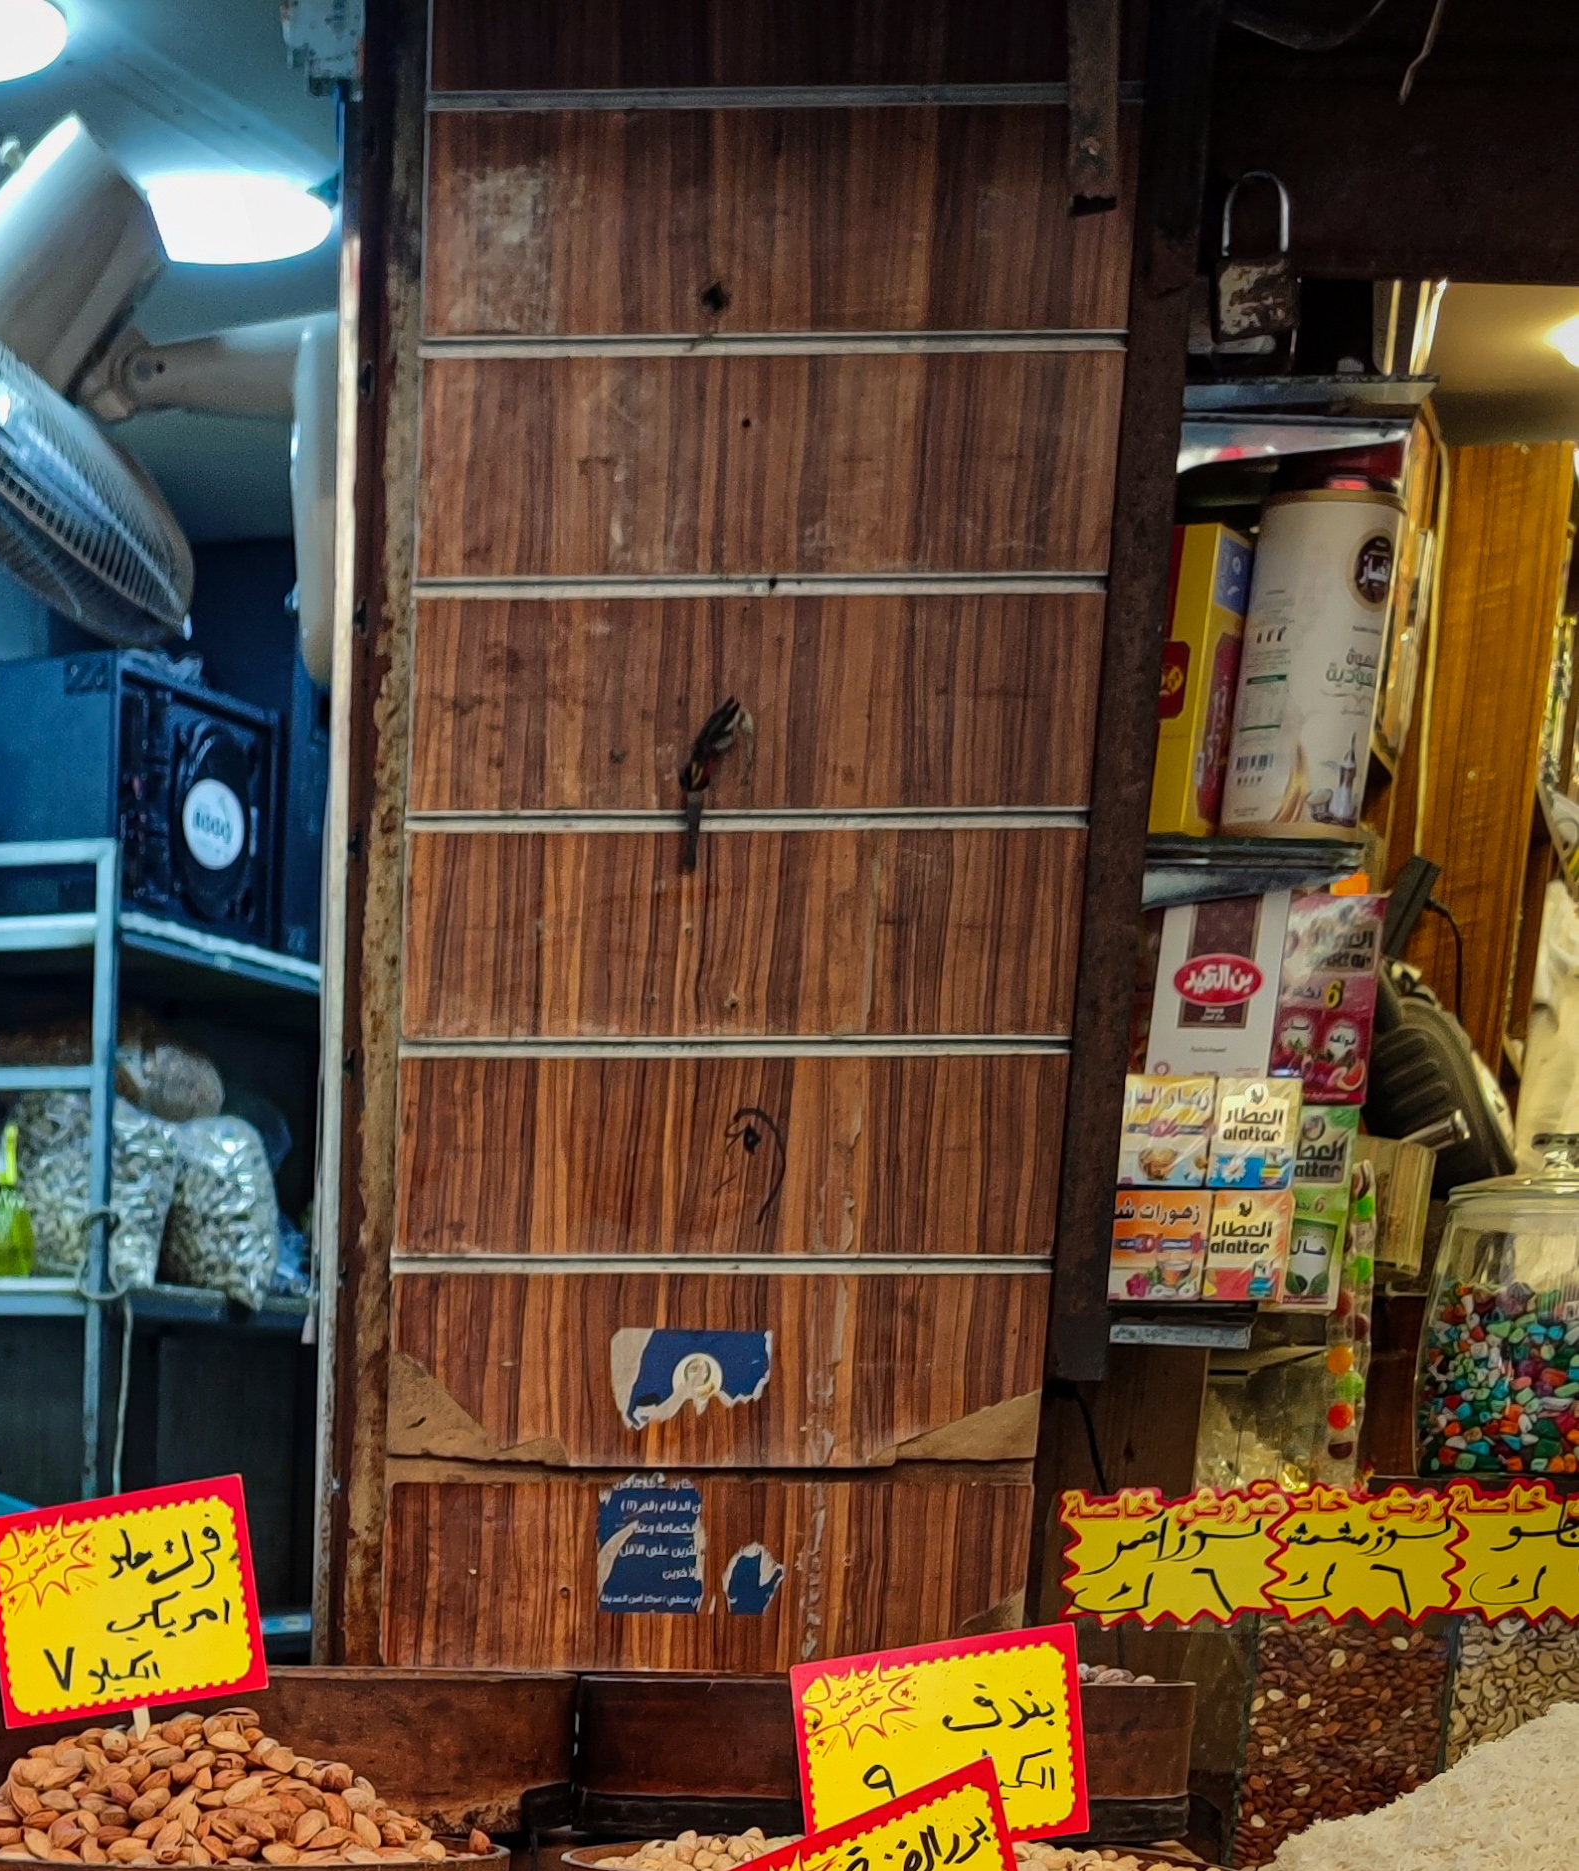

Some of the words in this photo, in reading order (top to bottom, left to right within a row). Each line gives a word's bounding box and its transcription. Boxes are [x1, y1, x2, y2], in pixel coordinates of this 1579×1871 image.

[1224, 1107, 1284, 1125] العطار
[1223, 1127, 1281, 1142] alattar
[1210, 1220, 1272, 1238] العطار
[1209, 1240, 1270, 1255] alattar
[1066, 1493, 1158, 1519] خاصة
[1175, 1490, 1284, 1525] عروض
[1368, 1490, 1449, 1521] روض
[1454, 1488, 1548, 1513] خاصة
[1144, 1517, 1262, 1563] لوز
[87, 1649, 161, 1696] الكيلو
